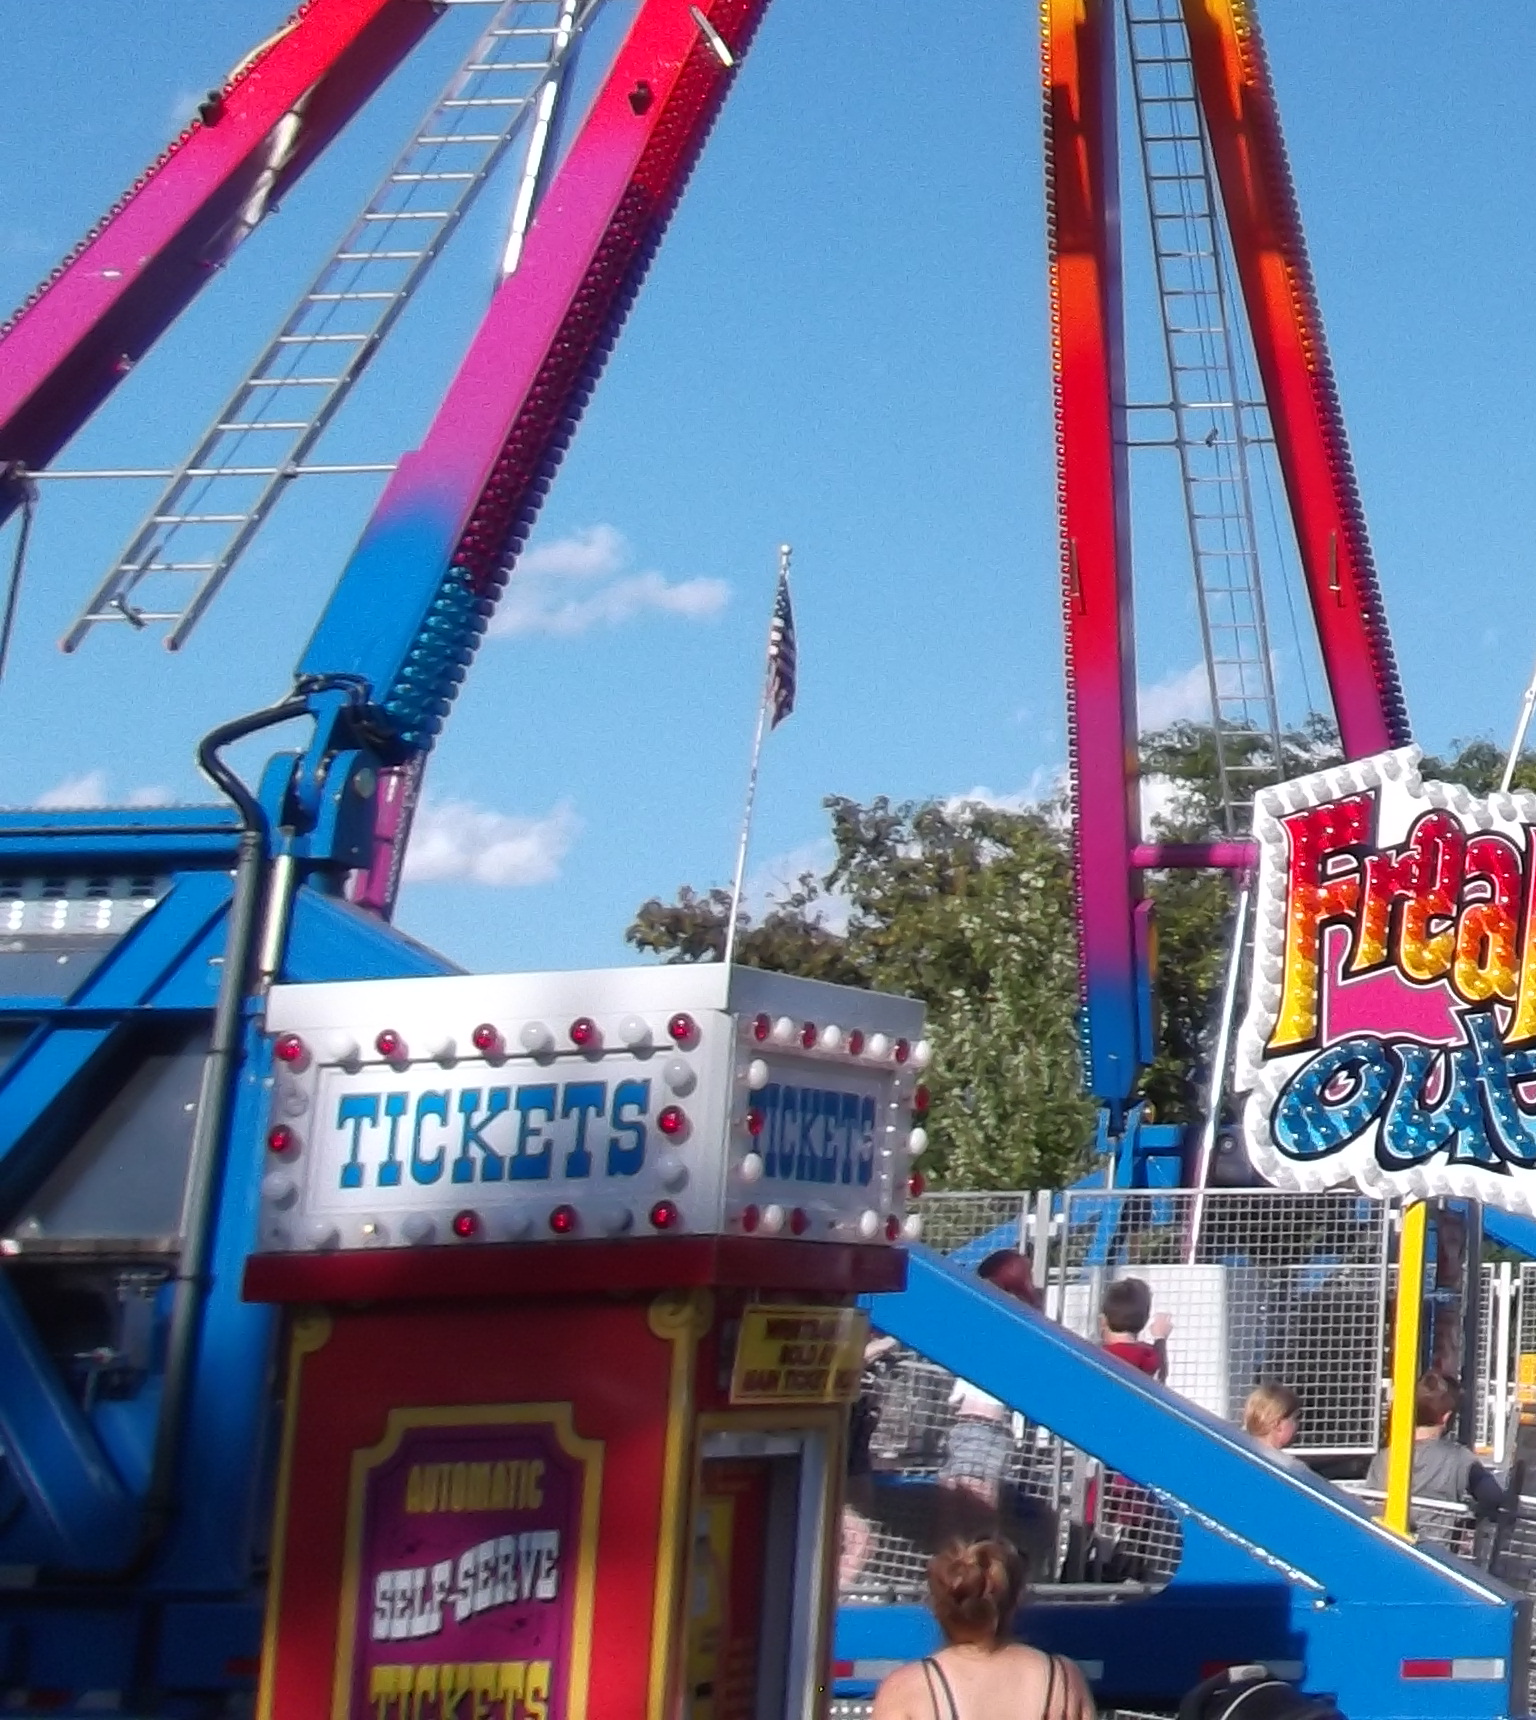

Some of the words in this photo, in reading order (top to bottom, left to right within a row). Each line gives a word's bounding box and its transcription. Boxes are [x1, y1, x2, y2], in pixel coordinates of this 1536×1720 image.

[336, 1078, 652, 1188] TICKETS
[747, 1083, 876, 1186] TICKETS
[405, 1458, 547, 1514] AUTOMATIC
[369, 1659, 553, 1720] TICKETS
